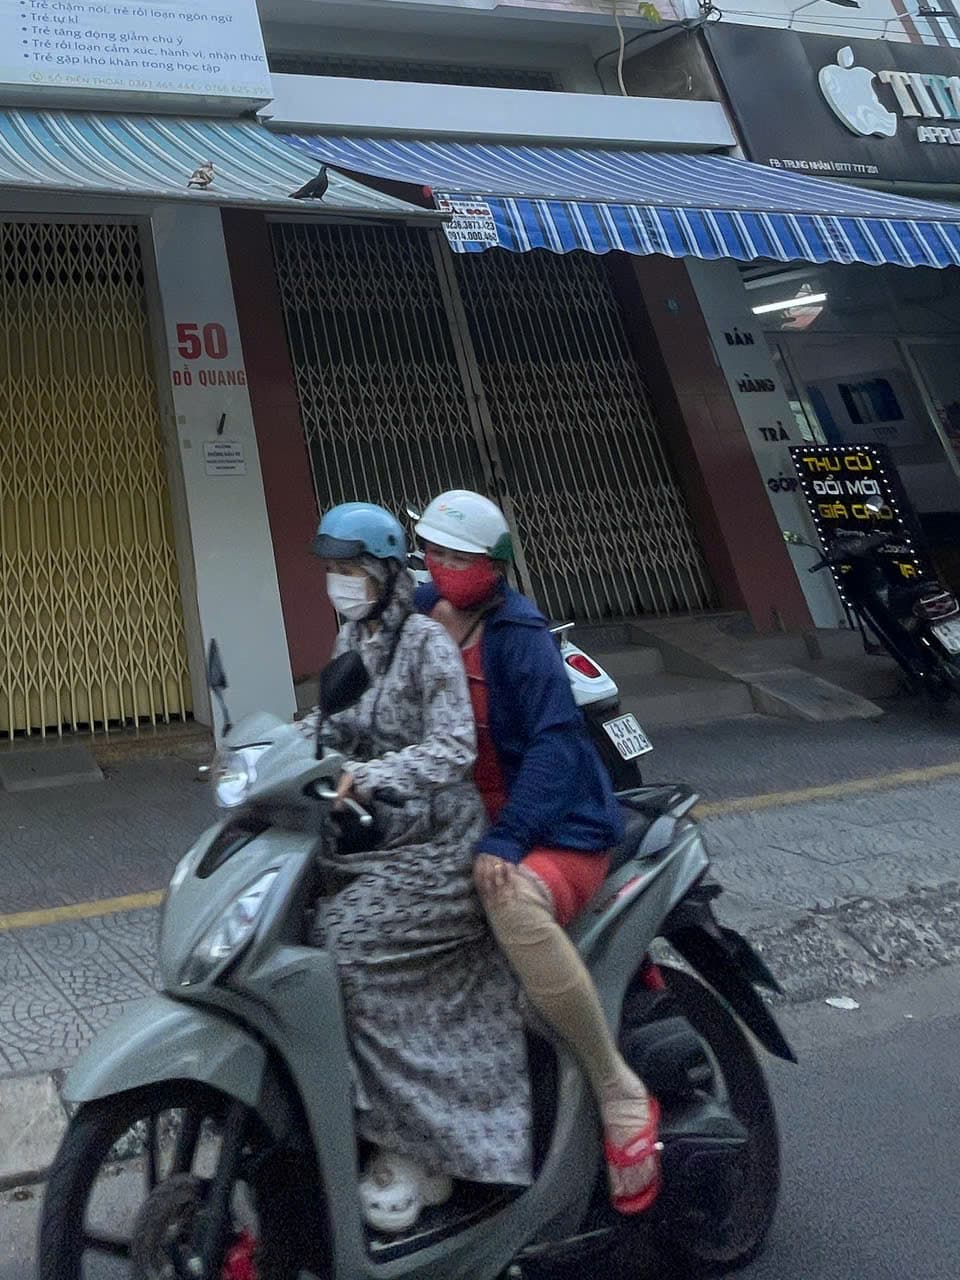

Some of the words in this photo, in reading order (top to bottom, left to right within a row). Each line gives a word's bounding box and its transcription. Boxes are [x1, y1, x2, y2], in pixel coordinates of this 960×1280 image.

[878, 70, 960, 120] TIT
[176, 323, 229, 360] 50
[724, 326, 755, 346] BÁN
[199, 370, 246, 387] QUANG
[738, 372, 776, 393] HÀNG
[802, 456, 841, 472] THU
